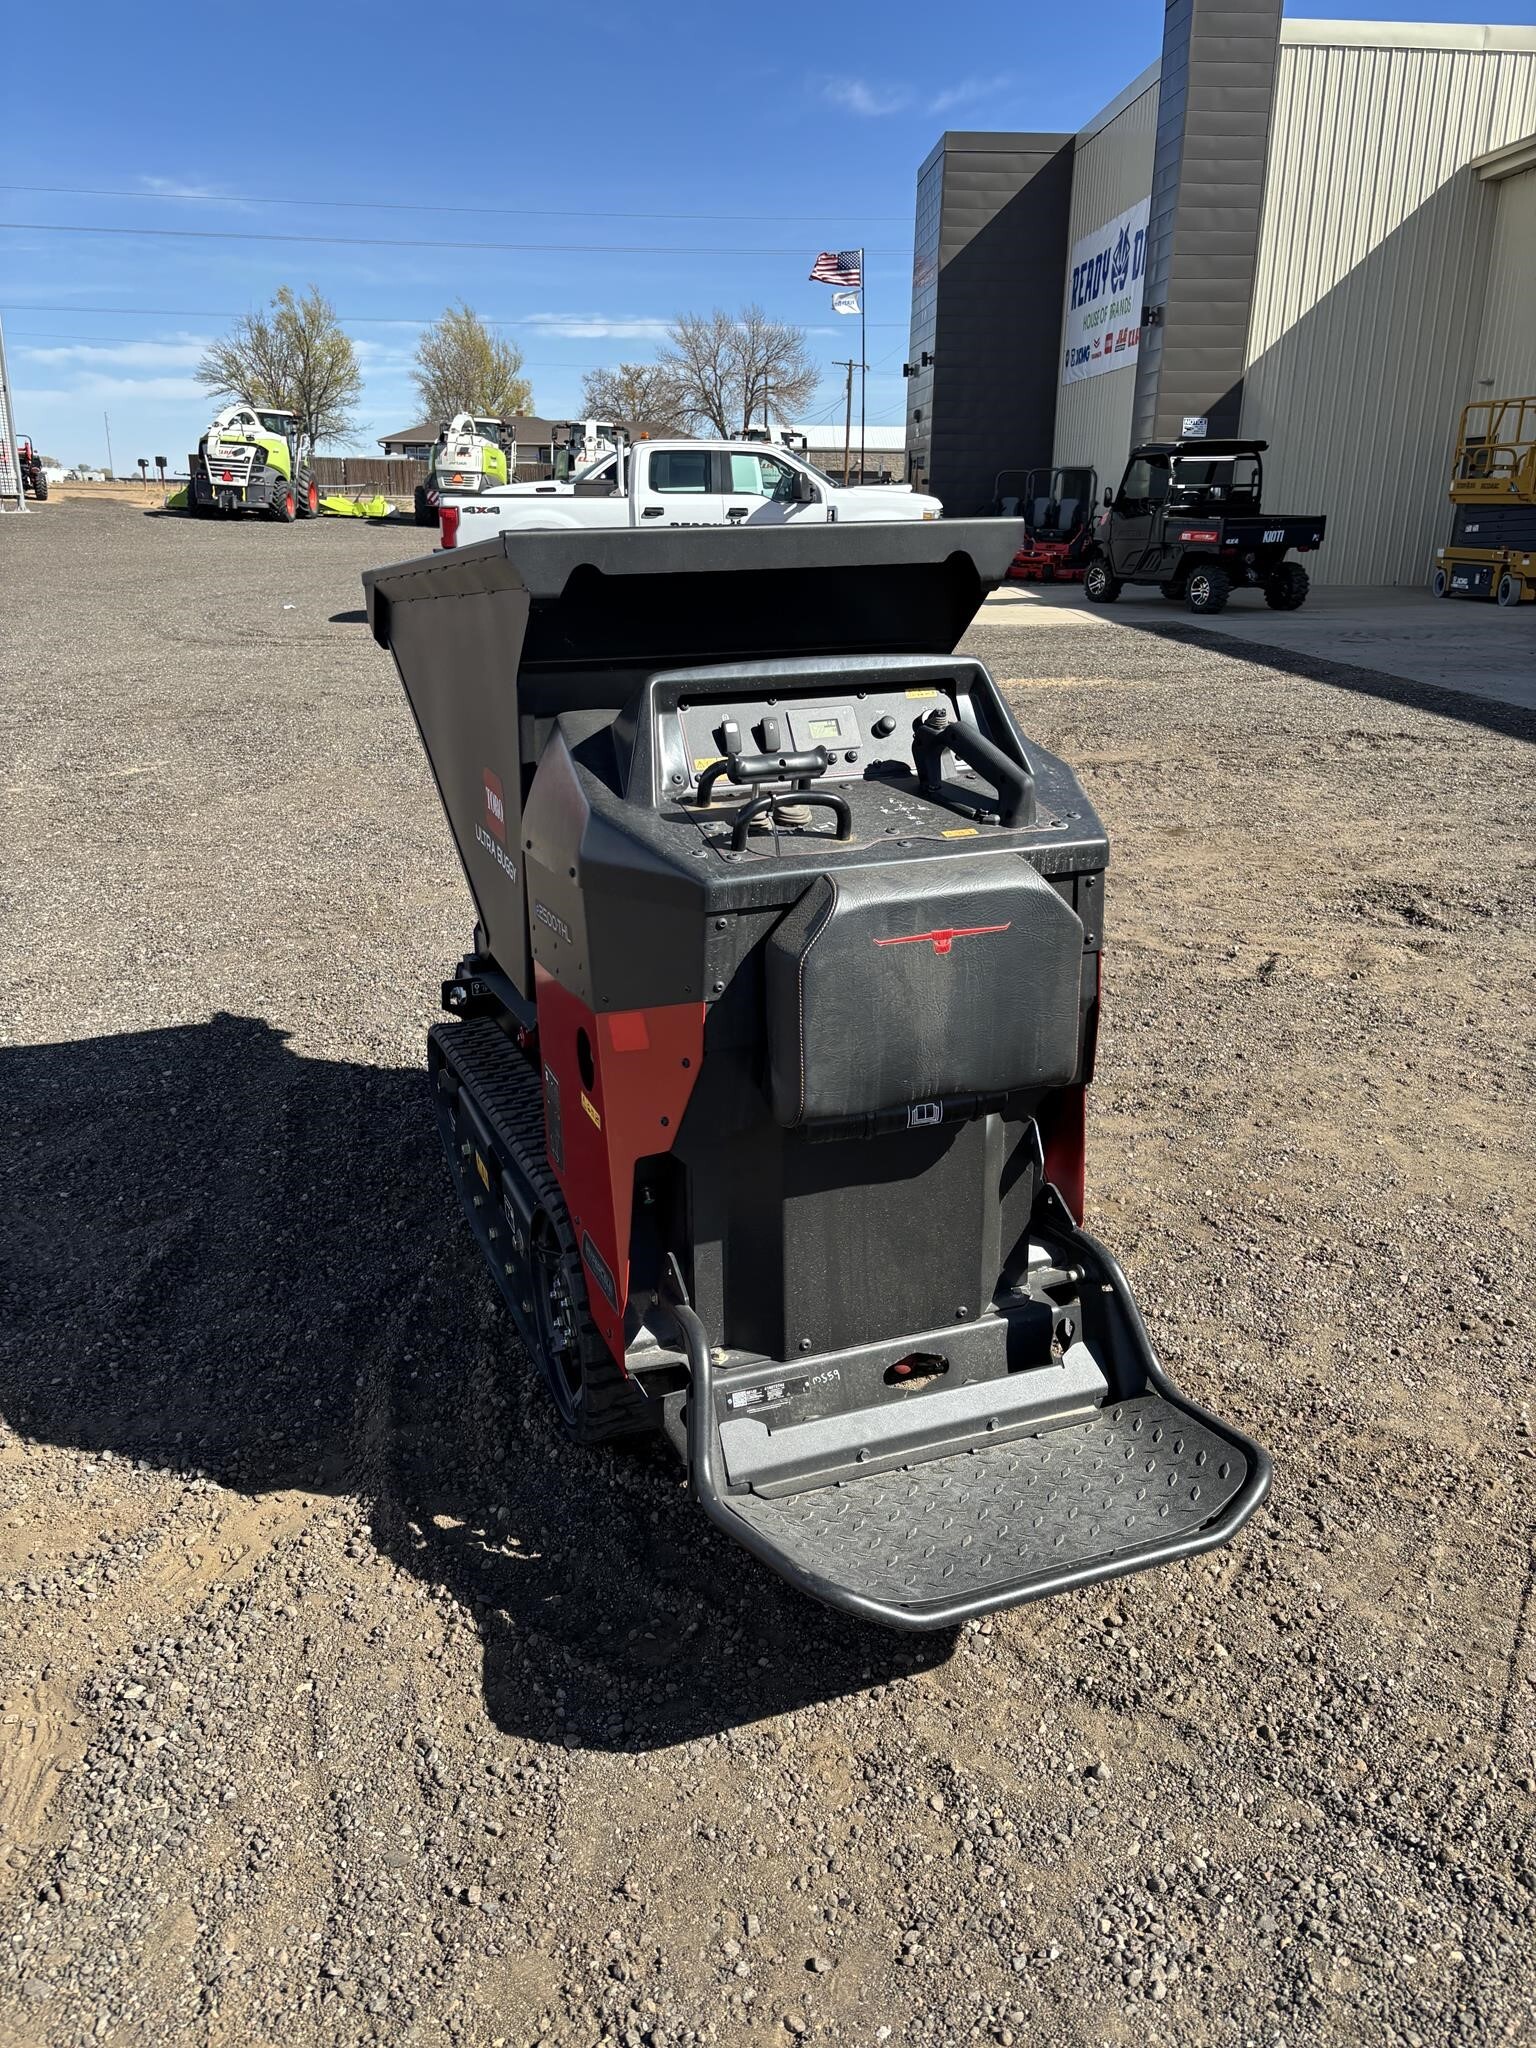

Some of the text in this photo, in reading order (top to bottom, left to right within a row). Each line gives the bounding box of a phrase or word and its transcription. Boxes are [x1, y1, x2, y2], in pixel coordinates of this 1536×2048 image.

[1071, 247, 1111, 311] READY
[1083, 296, 1131, 331] HOUSE OF BRANDS
[1262, 530, 1285, 543] KIOTI
[475, 823, 517, 884] ULTRA BUGGY
